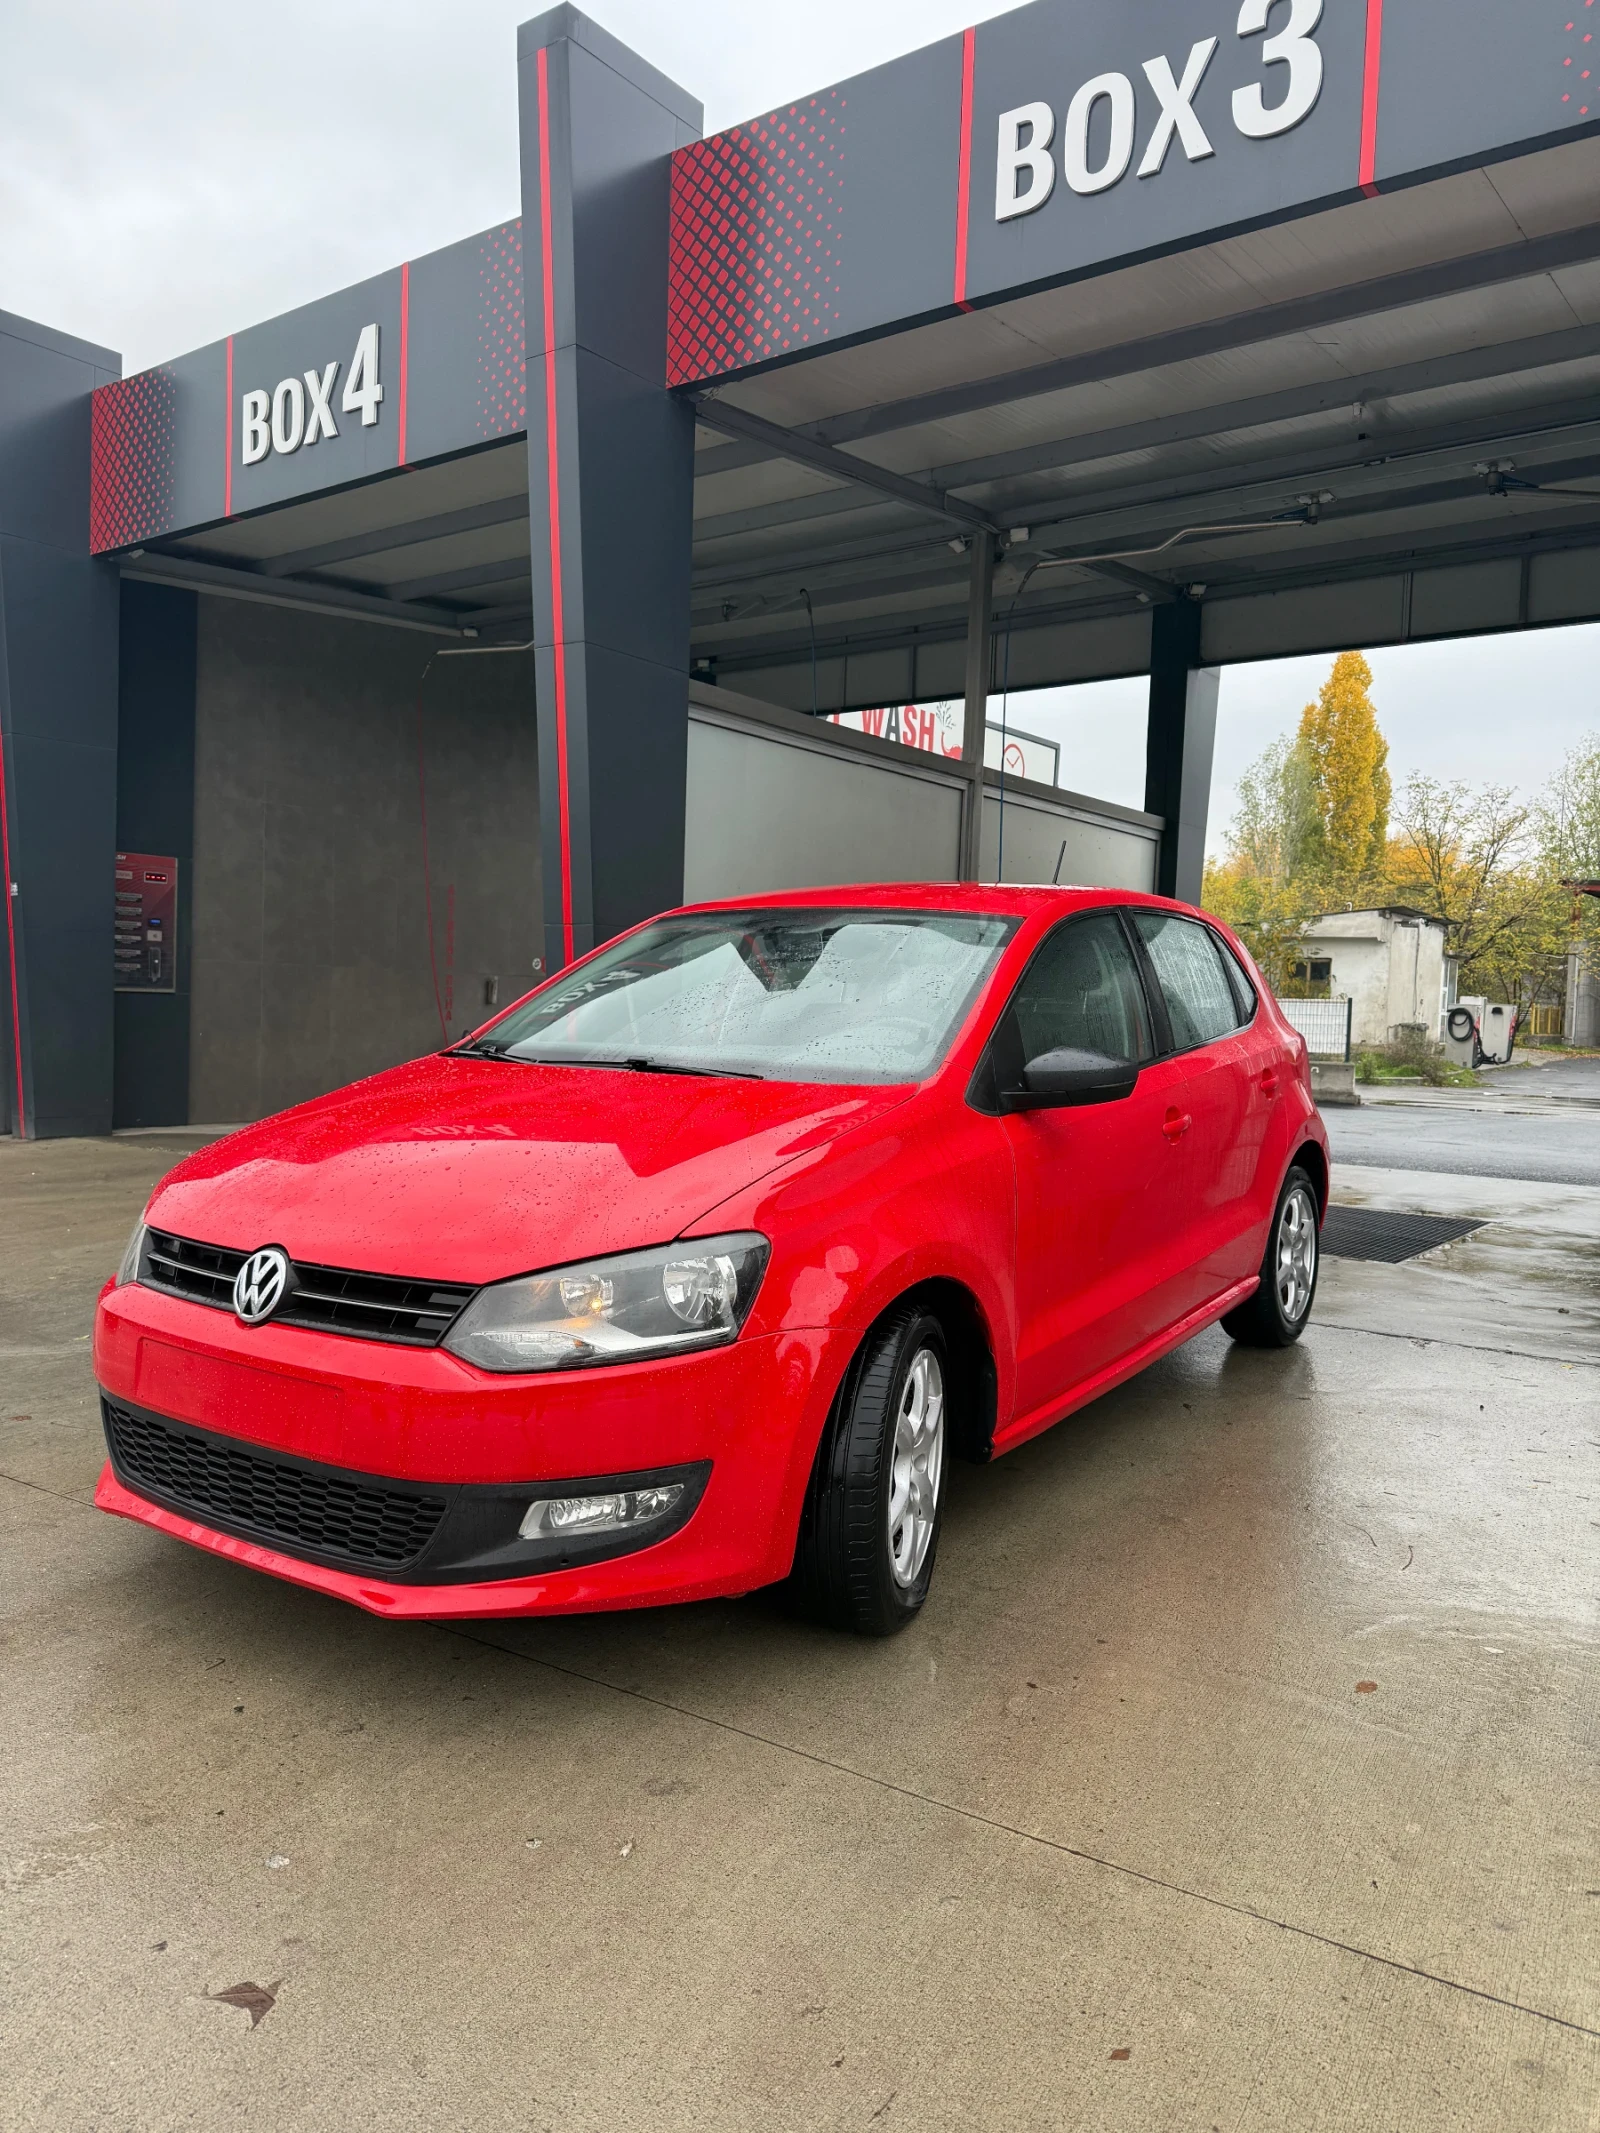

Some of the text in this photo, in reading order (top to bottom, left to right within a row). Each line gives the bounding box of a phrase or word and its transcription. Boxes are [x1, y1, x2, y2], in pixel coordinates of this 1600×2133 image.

[995, 0, 1324, 222] BOX 3
[242, 323, 383, 465] BOX 4
[234, 1251, 286, 1322] VW
